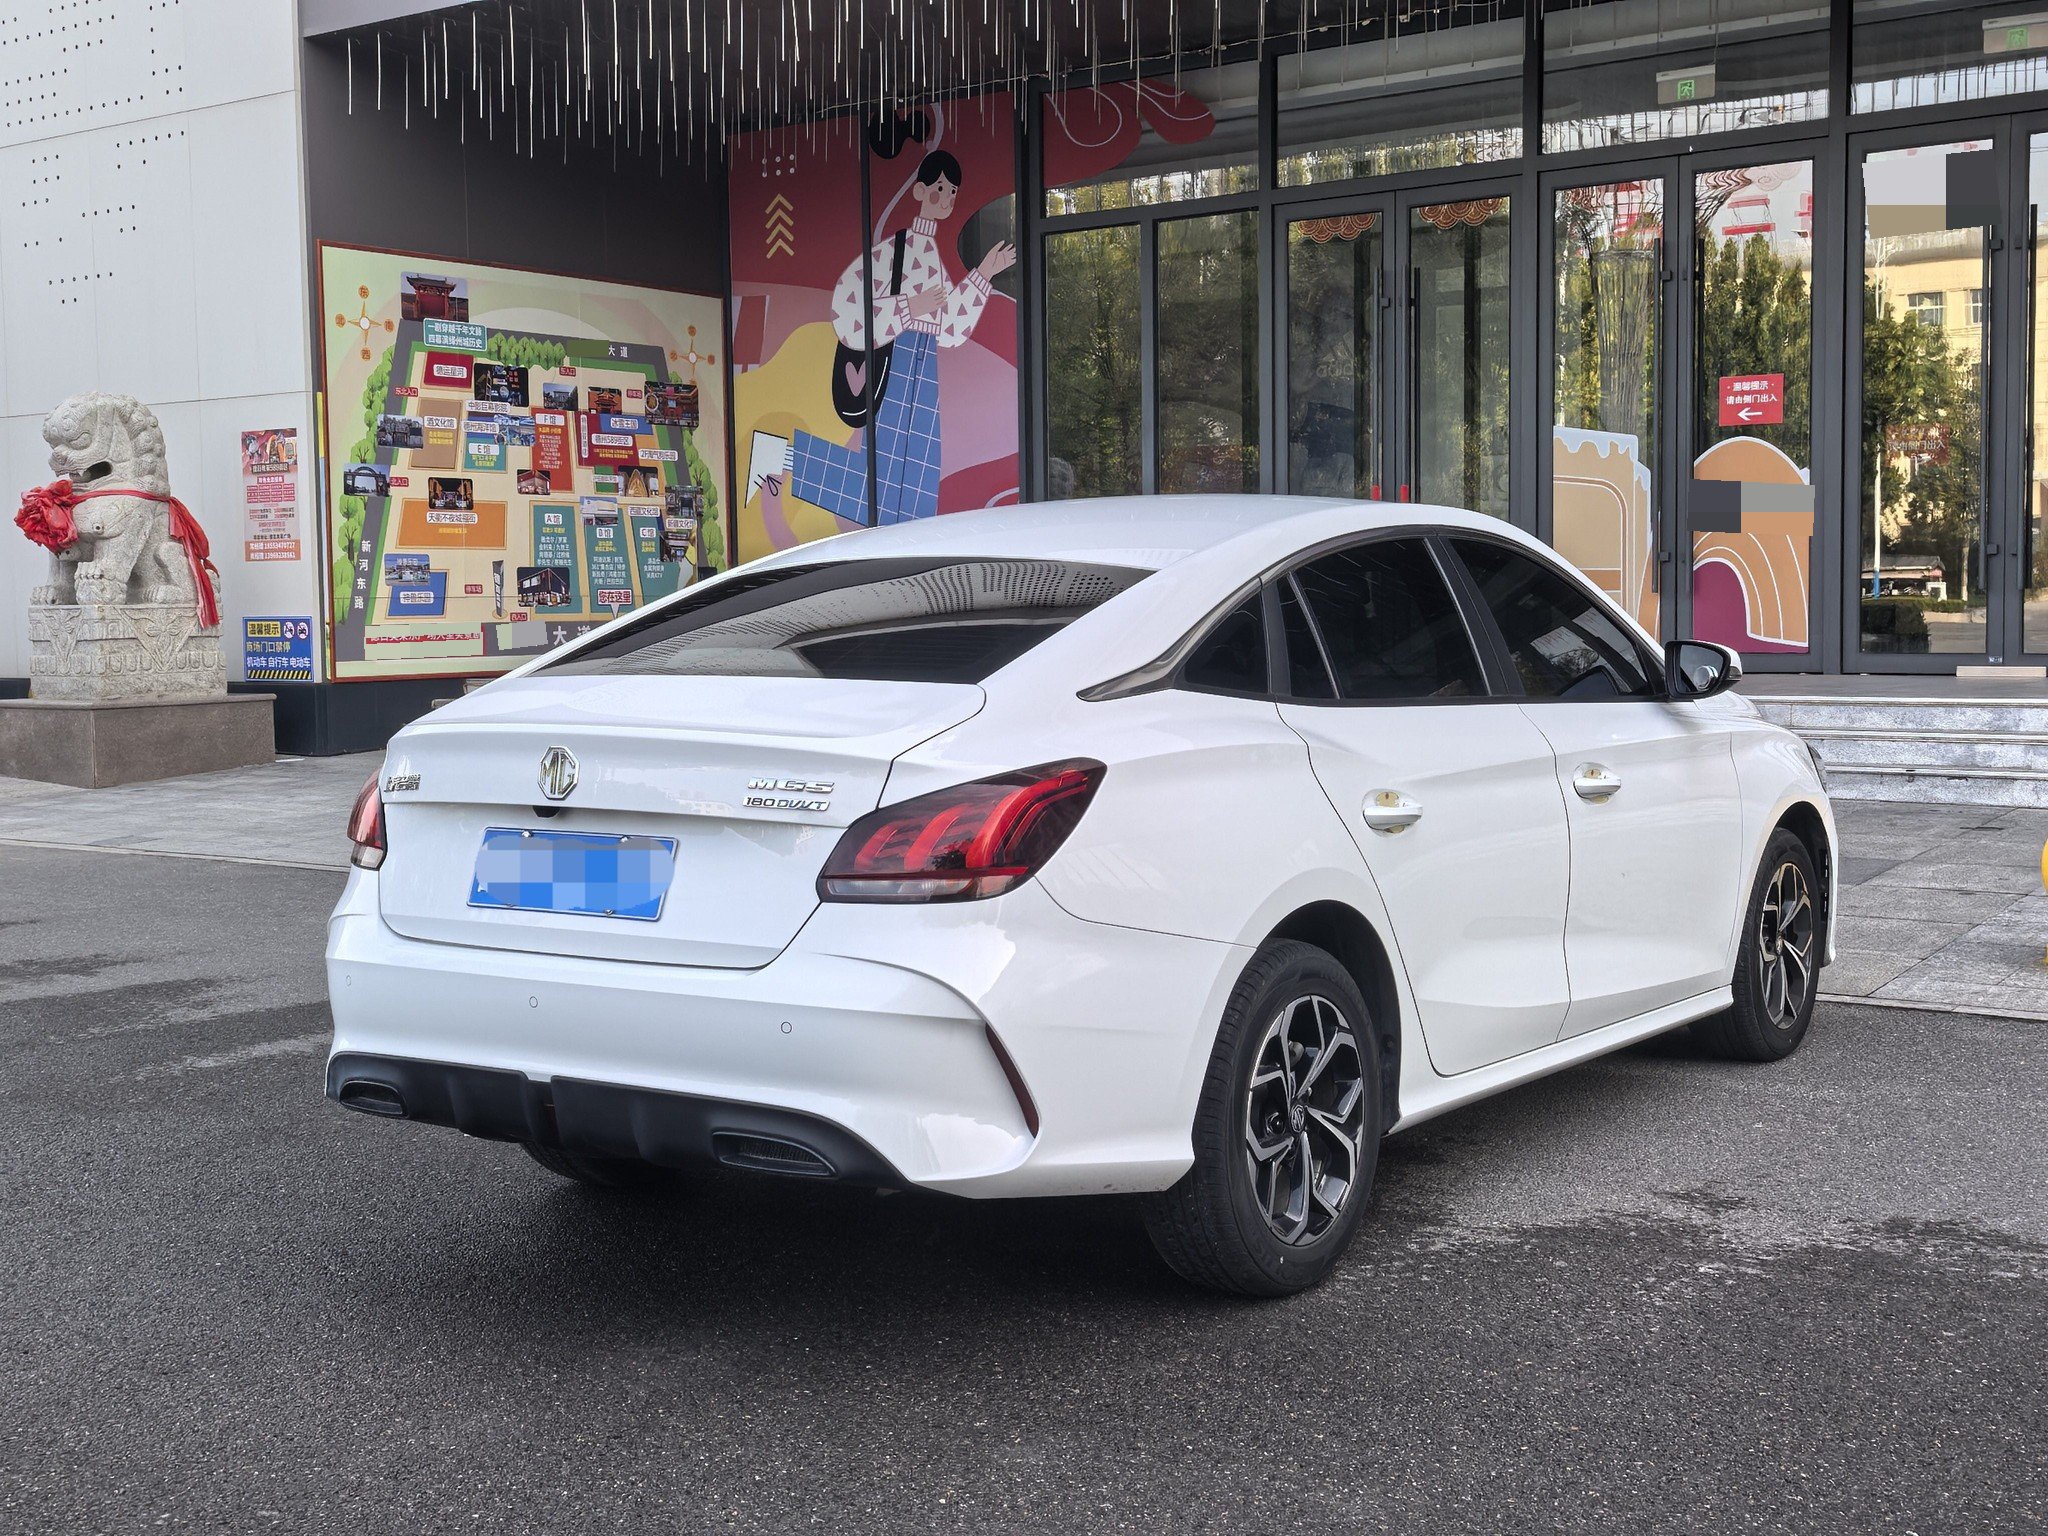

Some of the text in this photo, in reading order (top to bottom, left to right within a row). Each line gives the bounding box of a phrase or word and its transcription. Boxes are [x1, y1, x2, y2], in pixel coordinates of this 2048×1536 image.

[395, 387, 418, 396] 东北入口
[1733, 381, 1769, 391] 温馨提示
[1726, 394, 1778, 405] 请由侧门出入
[426, 417, 456, 428] 酒文化馆
[354, 540, 372, 609] 新河东路
[598, 590, 631, 604] 您在这里
[249, 623, 279, 636] 温馨提示
[246, 641, 291, 653] 商场门口禁停
[246, 656, 311, 668] 机动车 自行车 电动车
[541, 749, 577, 797] MG
